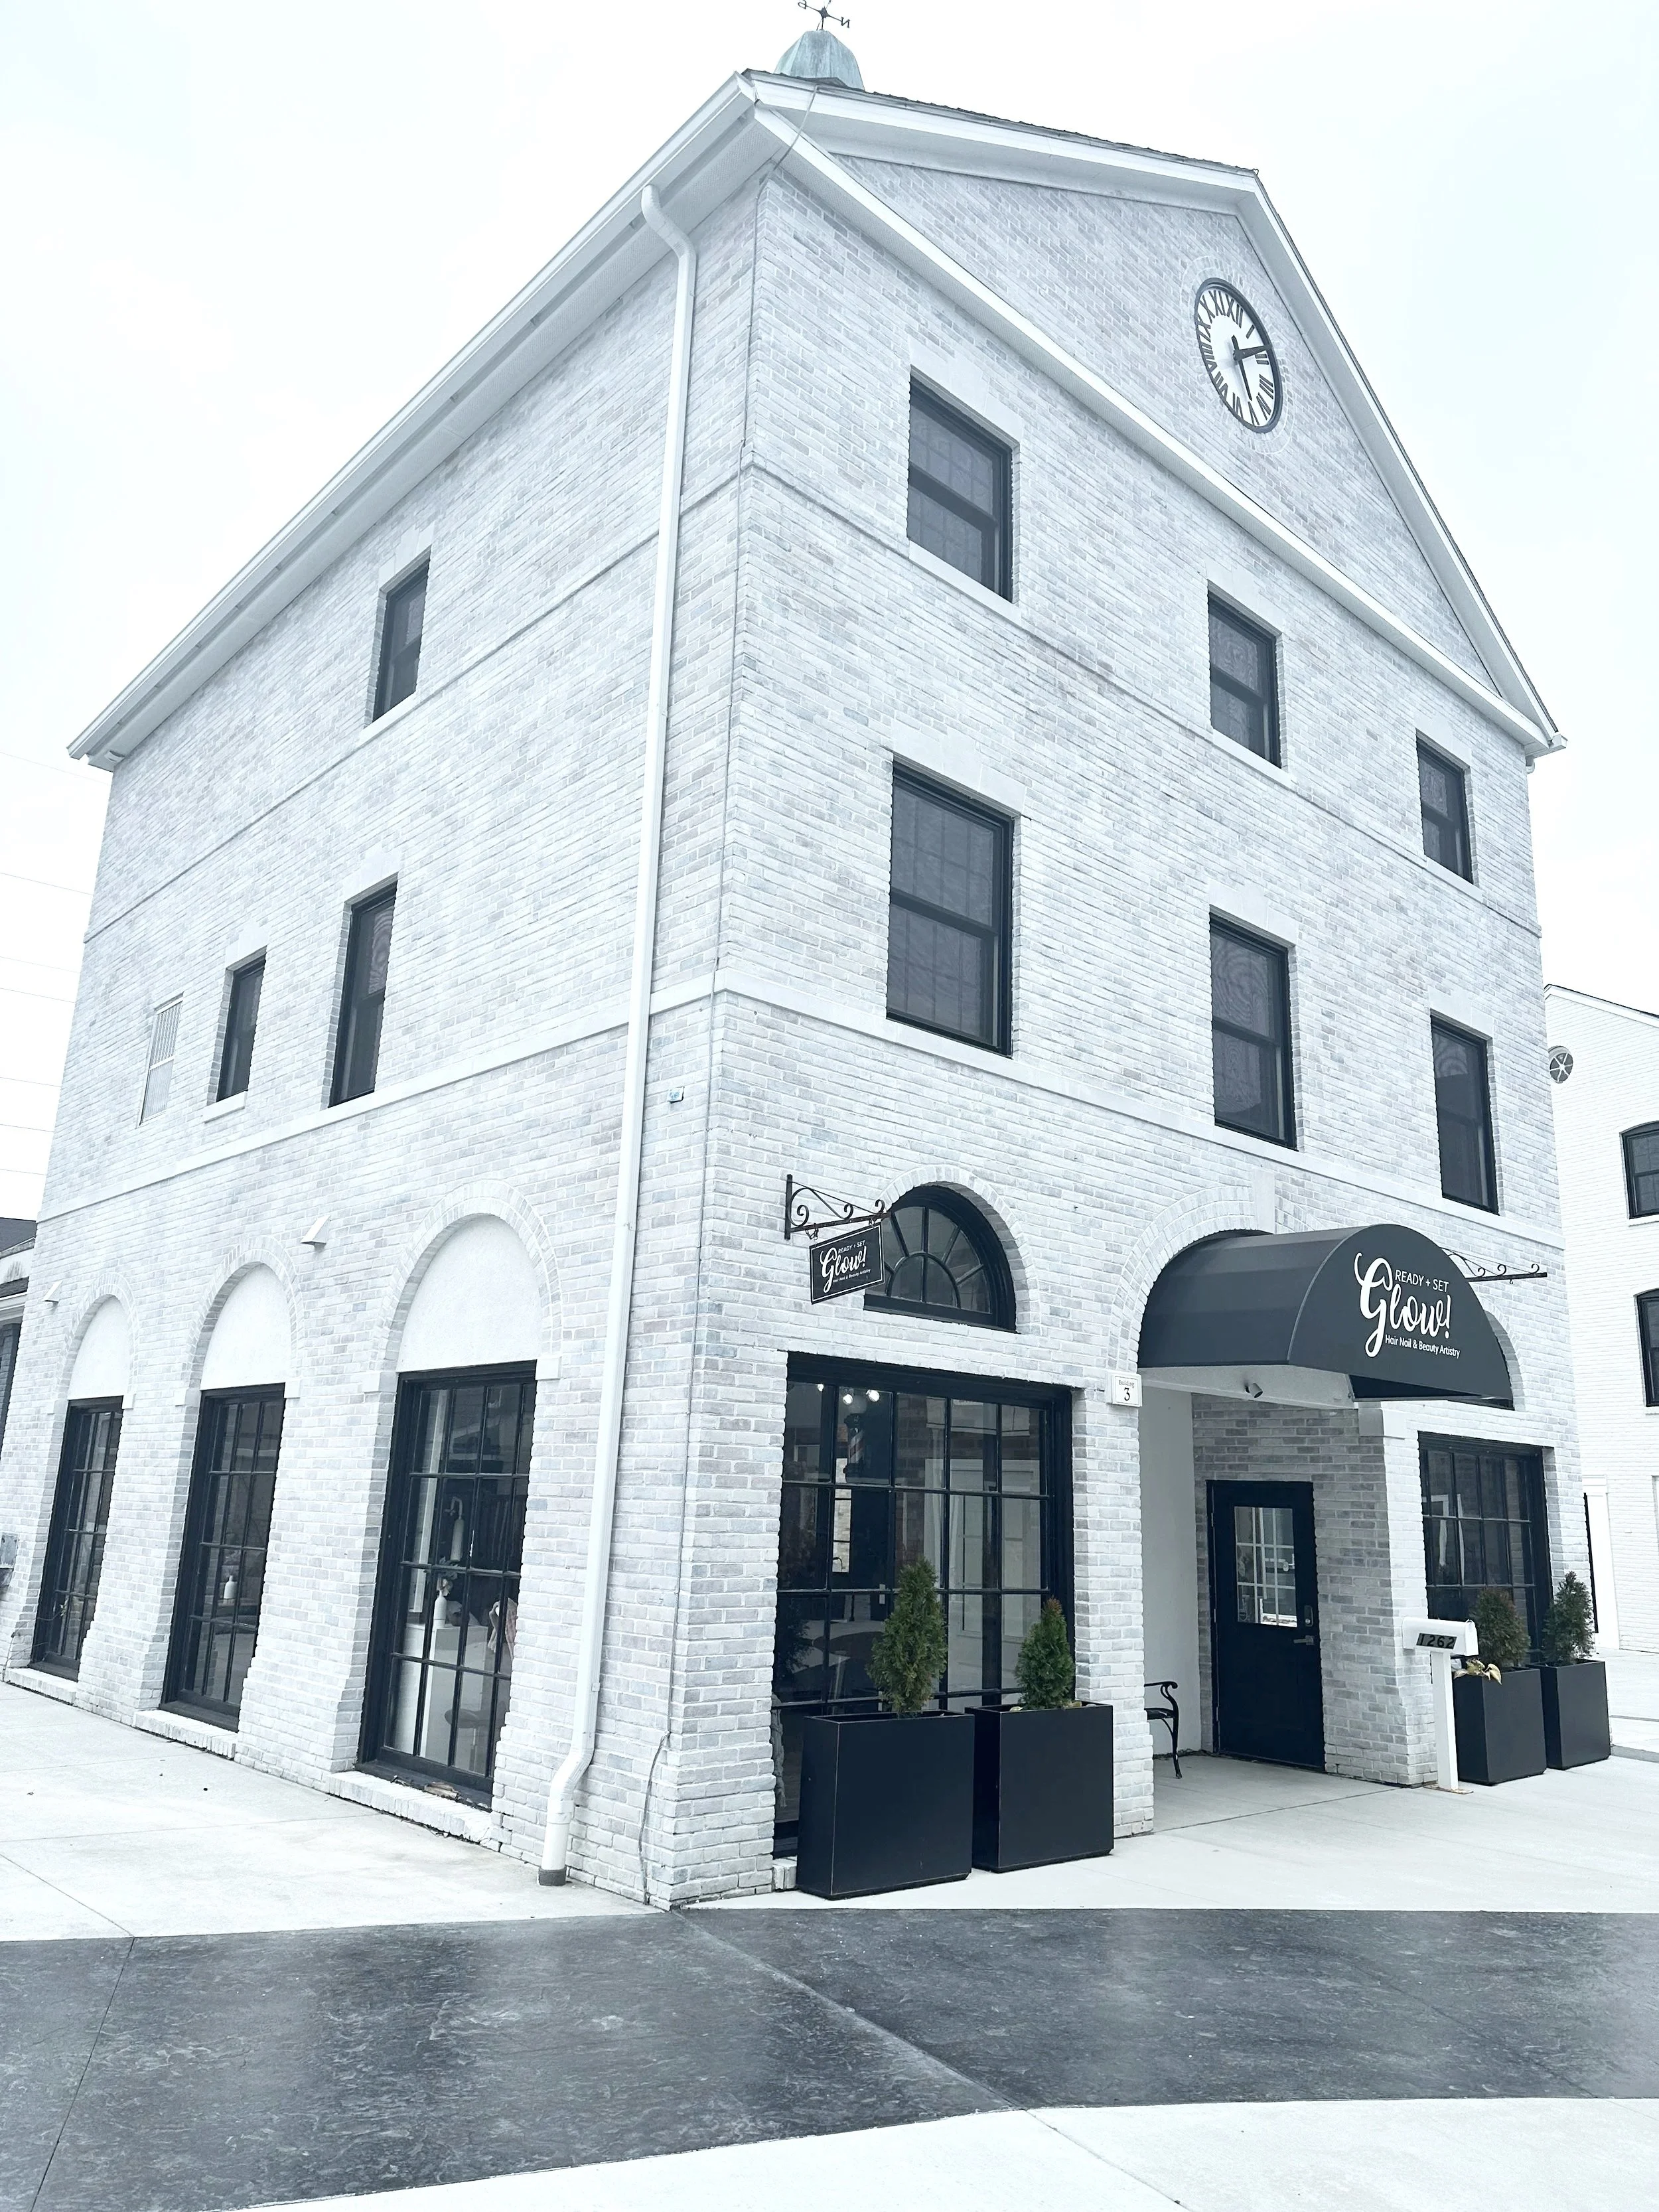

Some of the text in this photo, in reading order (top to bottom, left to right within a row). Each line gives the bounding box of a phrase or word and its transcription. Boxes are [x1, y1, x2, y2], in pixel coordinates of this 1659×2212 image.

[1199, 294, 1216, 324] X
[1259, 374, 1274, 400] III
[1247, 401, 1260, 426] V
[838, 1244, 853, 1254] READY
[820, 1245, 867, 1293] Glow!
[1395, 1269, 1449, 1293] READY + SET
[1354, 1252, 1452, 1358] Glow!
[1385, 1334, 1461, 1359] Hair Nail & Beauty Artistry
[1124, 1387, 1130, 1401] 3
[1419, 1633, 1455, 1649] 1262
